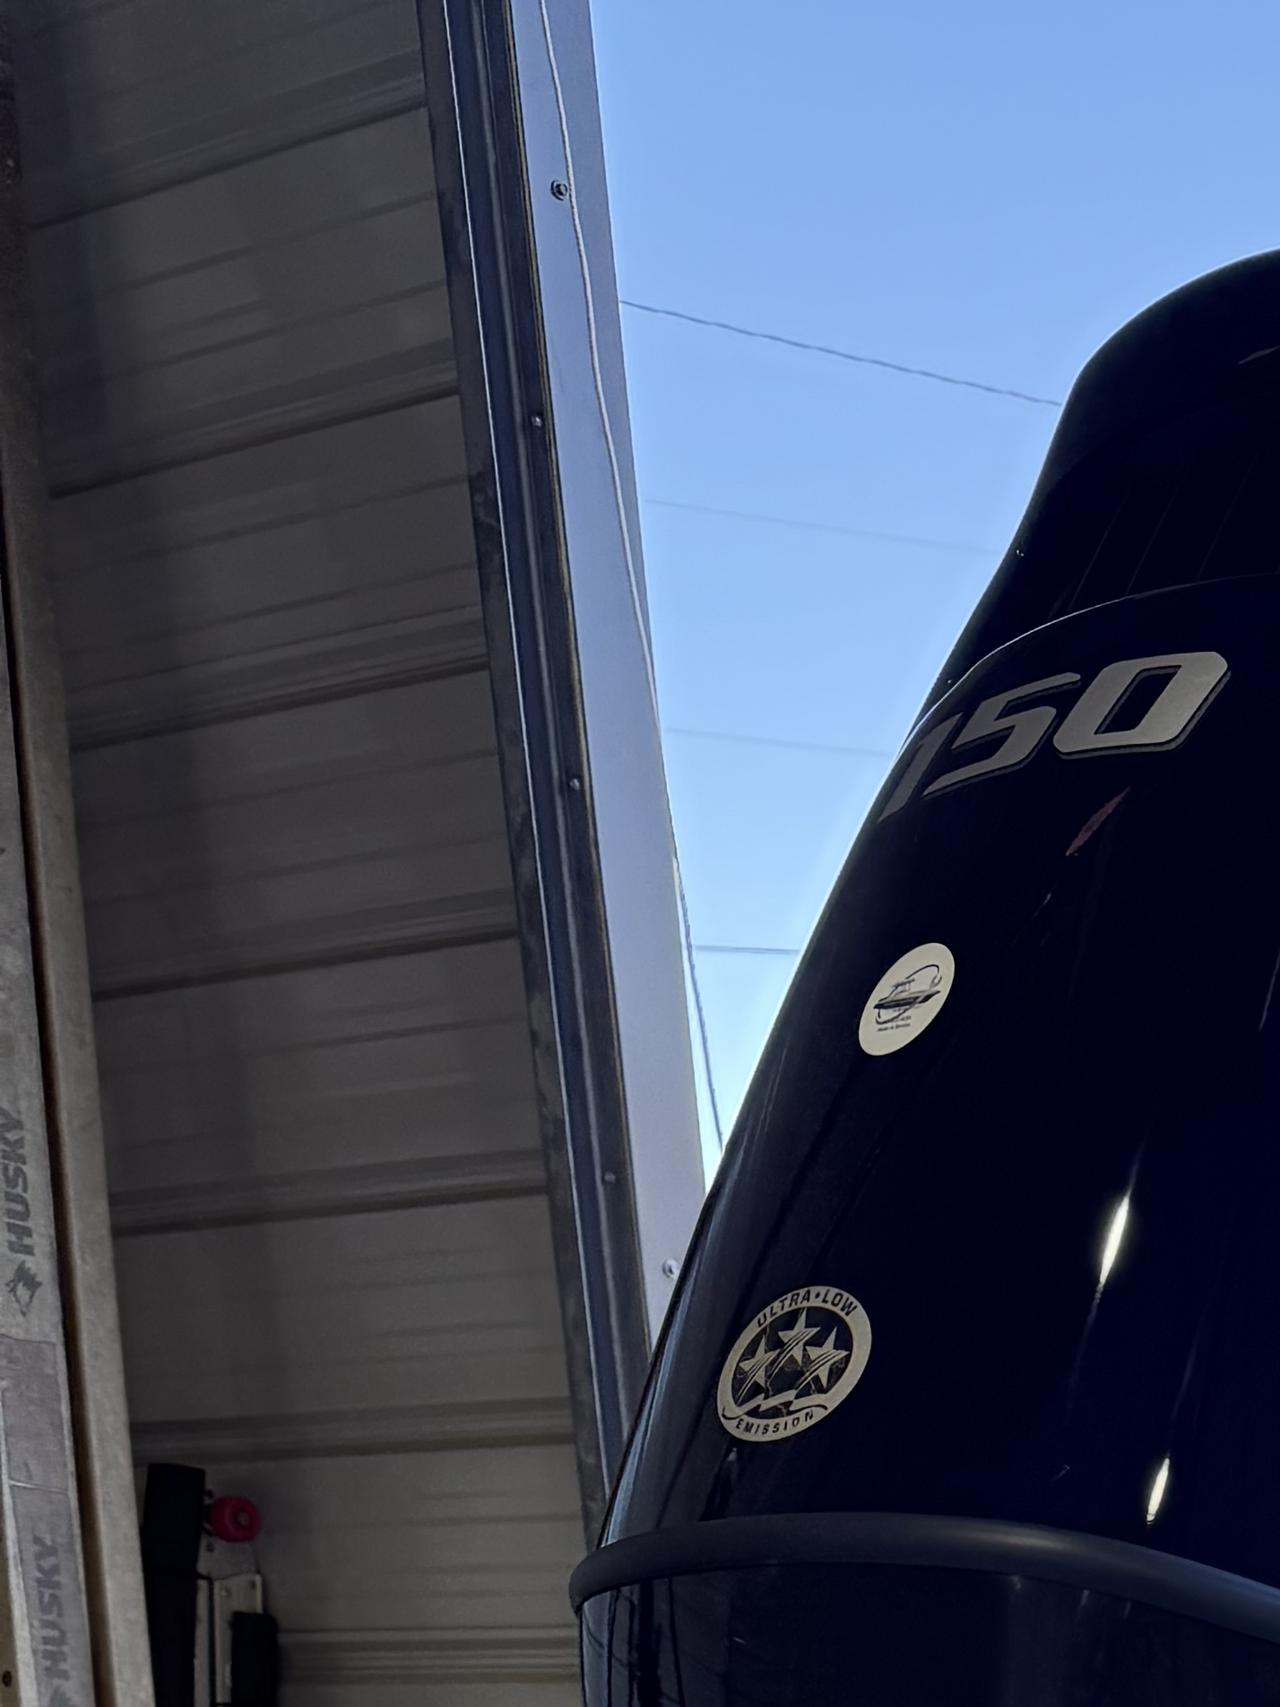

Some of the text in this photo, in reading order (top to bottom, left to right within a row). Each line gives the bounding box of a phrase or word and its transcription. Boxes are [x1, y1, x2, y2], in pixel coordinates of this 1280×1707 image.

[877, 651, 1232, 825] 150
[0, 1105, 36, 1257] HUSKY
[735, 1409, 815, 1436] EMISSION
[33, 1533, 71, 1682] HUSKY
